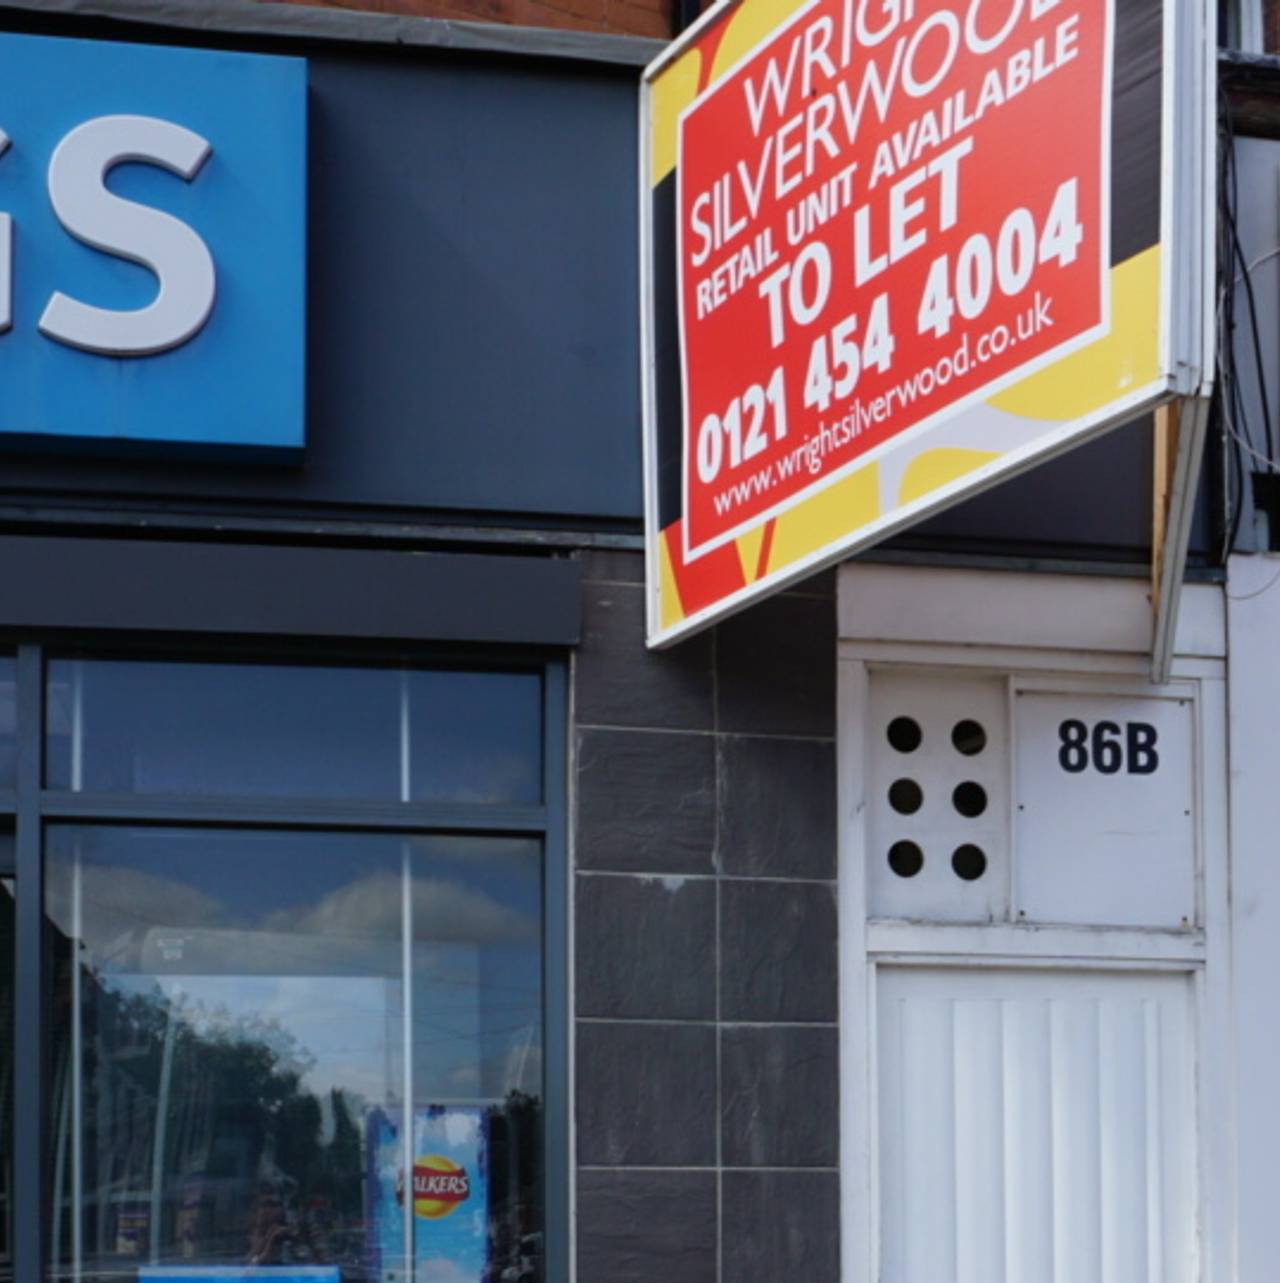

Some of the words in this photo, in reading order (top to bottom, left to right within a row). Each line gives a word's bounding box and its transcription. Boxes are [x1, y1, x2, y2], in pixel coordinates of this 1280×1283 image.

[696, 234, 778, 319] RETAIL
[786, 164, 856, 245] UNIT
[868, 16, 1079, 188] AVAILABLE
[744, 0, 916, 136] WRIG
[696, 368, 786, 484] 0121
[803, 294, 895, 414] 454
[917, 177, 1082, 339] 4004
[758, 242, 831, 349] TO
[853, 138, 973, 287] LET
[712, 291, 1053, 516] www.wrightsilverwood.co.uk
[1058, 718, 1159, 775] 86B
